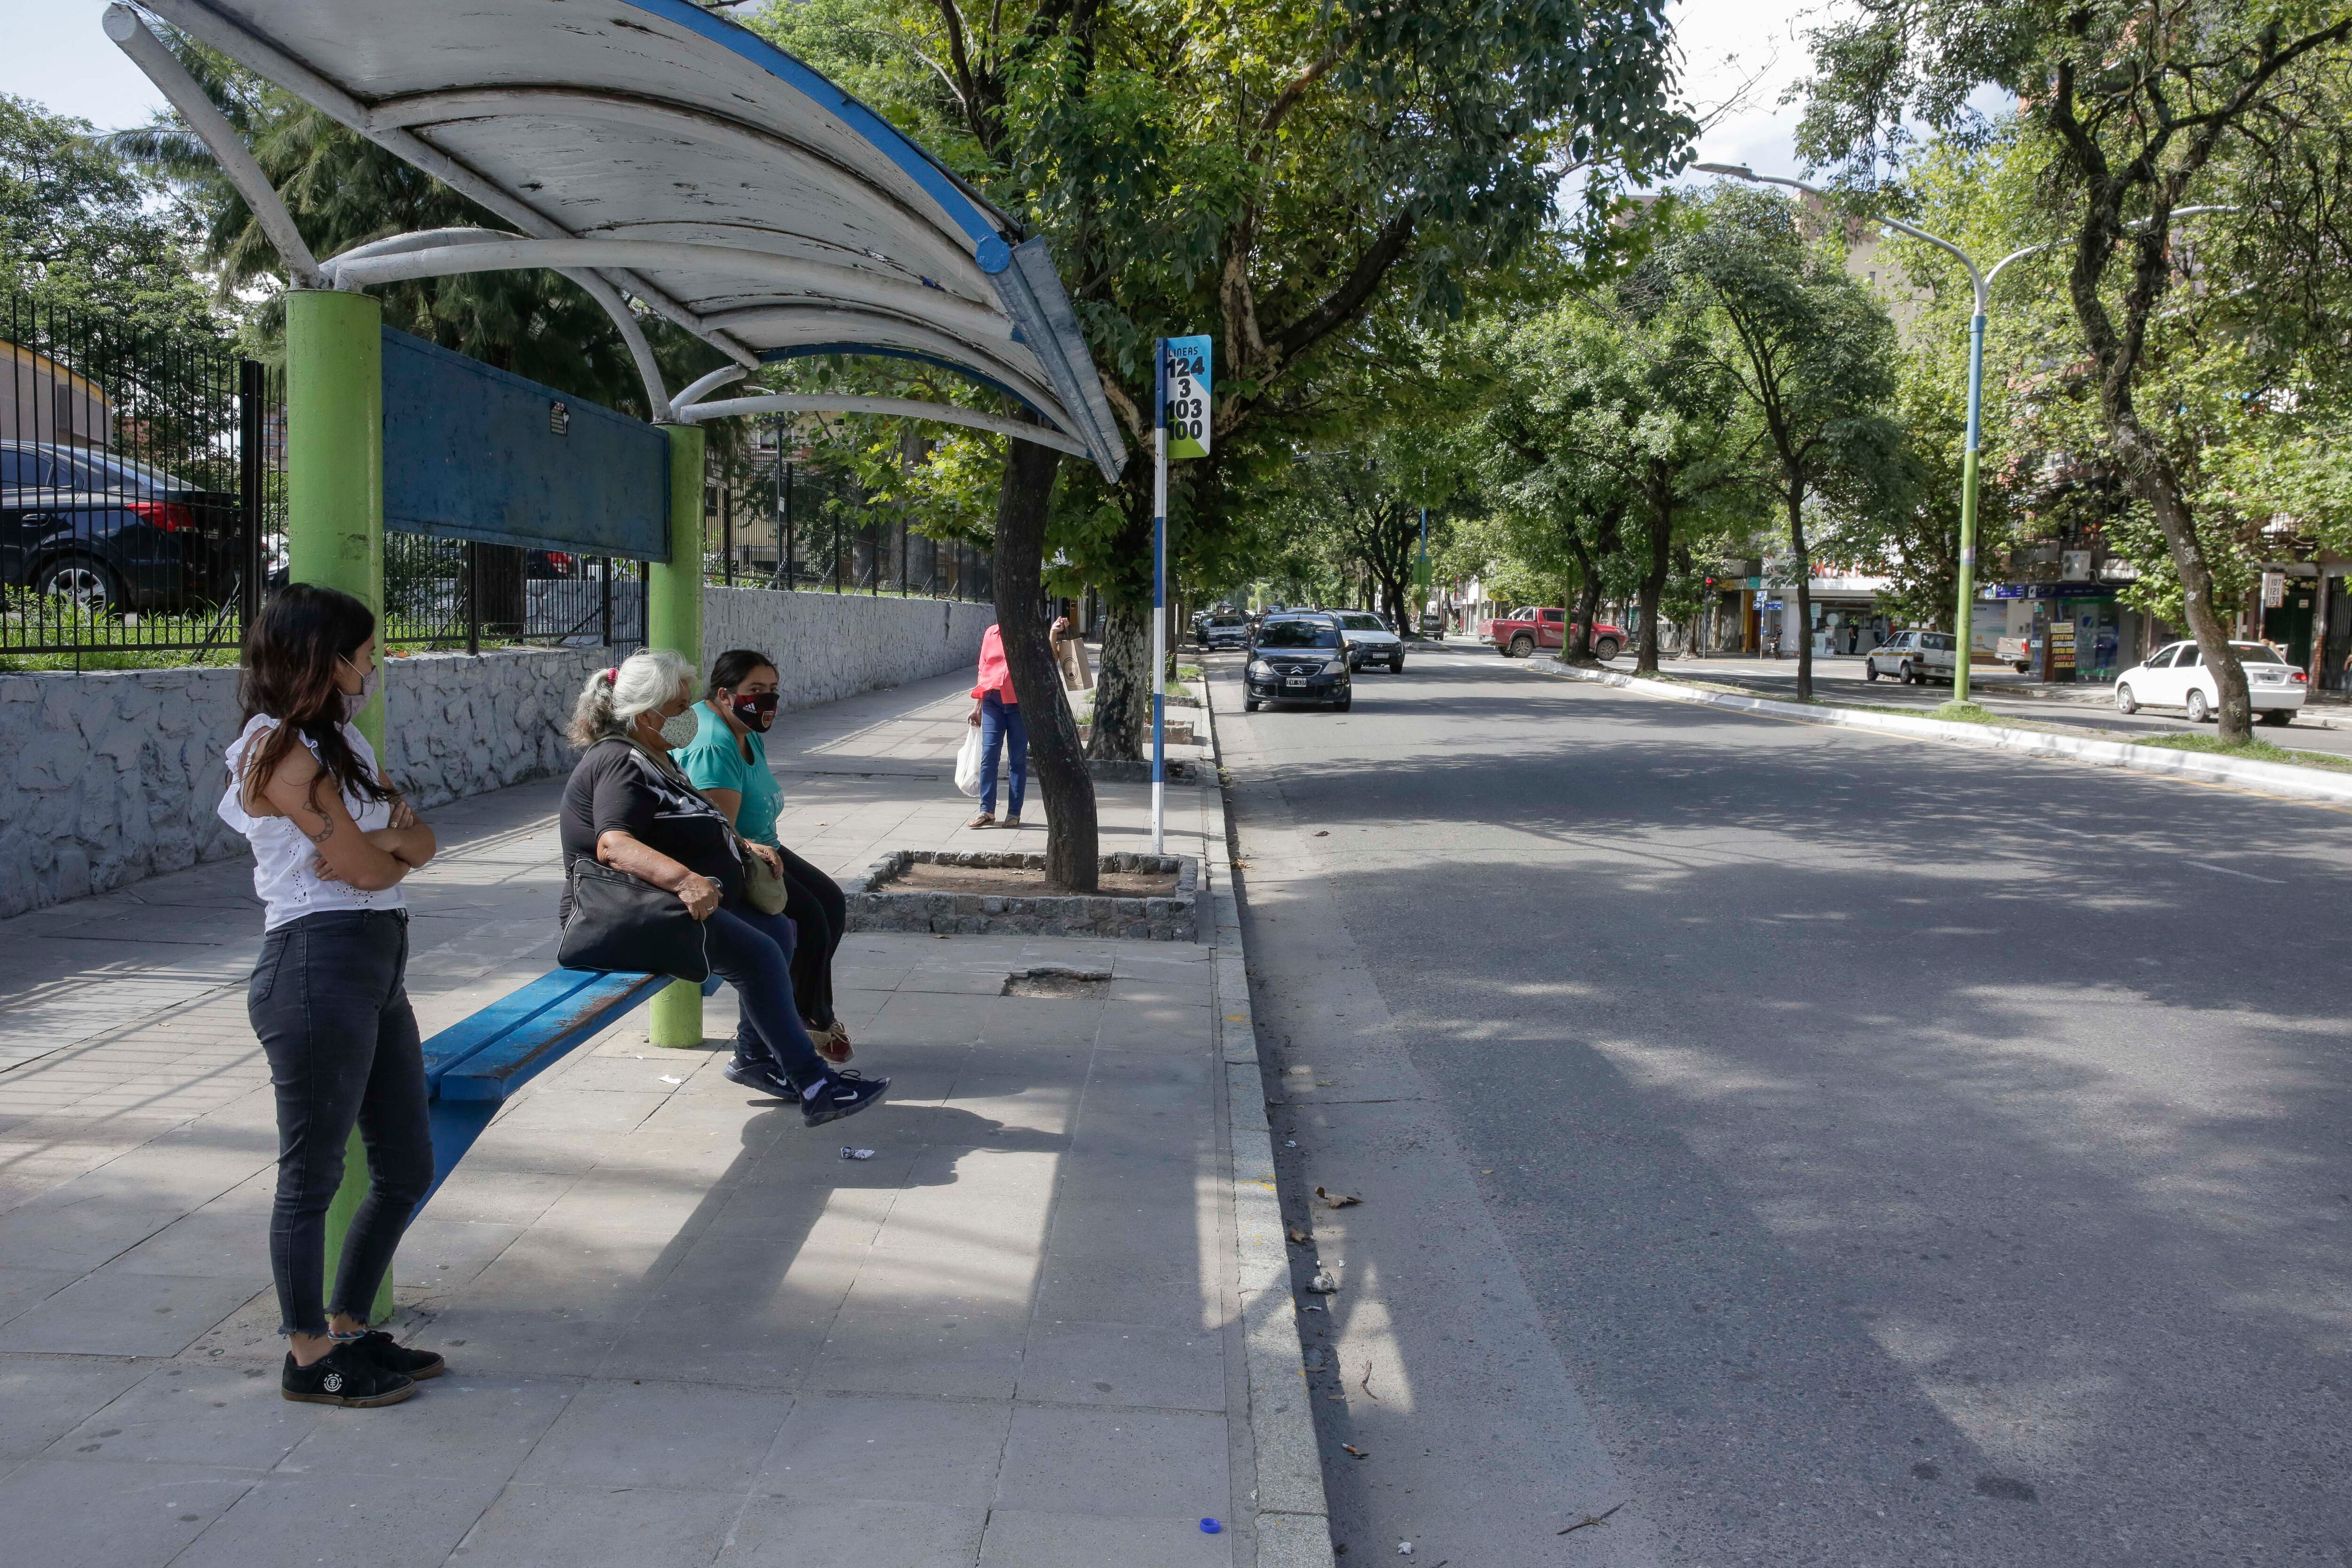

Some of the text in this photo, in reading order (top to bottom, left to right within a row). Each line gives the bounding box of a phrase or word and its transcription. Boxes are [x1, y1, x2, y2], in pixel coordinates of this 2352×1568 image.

[1169, 347, 1198, 357] LINEAS
[1167, 356, 1204, 378] 124
[1178, 378, 1191, 398] 3
[1167, 398, 1202, 420] 103
[1167, 420, 1202, 440] 100
